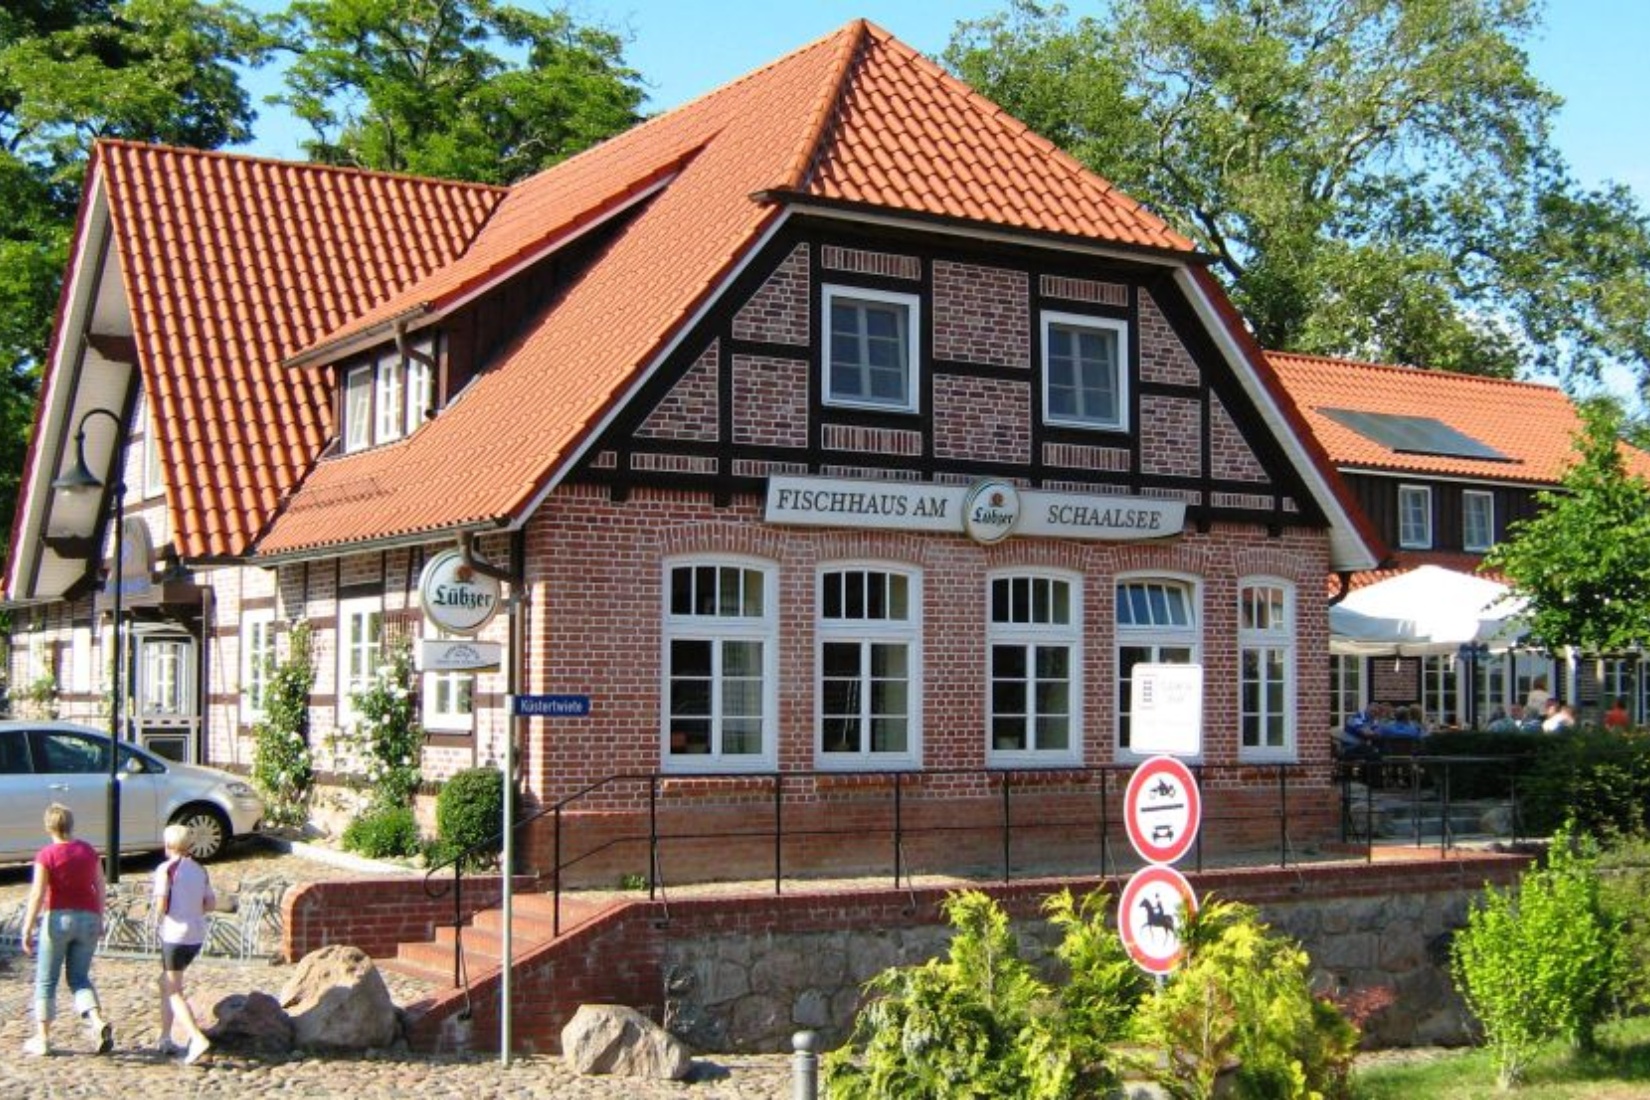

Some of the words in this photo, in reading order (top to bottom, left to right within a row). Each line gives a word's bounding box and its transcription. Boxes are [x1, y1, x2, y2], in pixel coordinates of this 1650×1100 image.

[776, 488, 908, 516] FISCHHAUS
[912, 496, 949, 518] AM
[1047, 504, 1162, 529] SCHAALSEE
[432, 584, 493, 609] Lübzer
[520, 698, 583, 713] Küstertwiete
